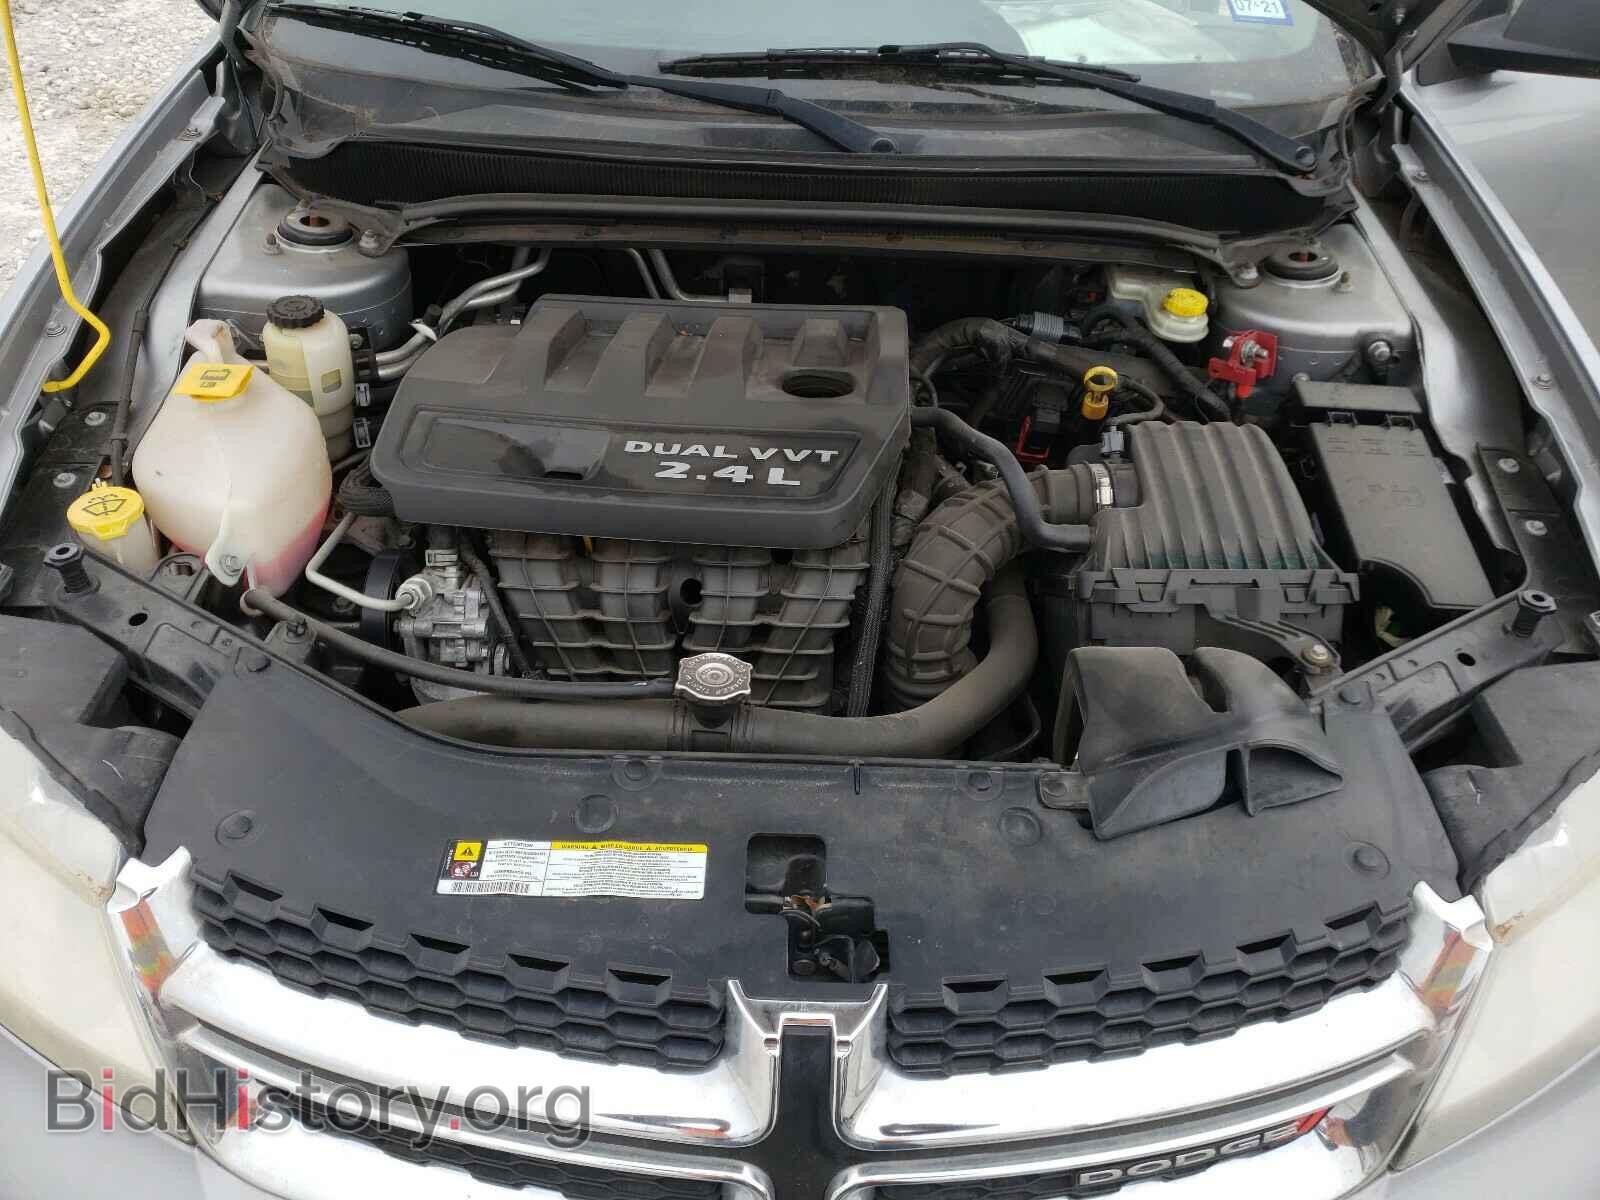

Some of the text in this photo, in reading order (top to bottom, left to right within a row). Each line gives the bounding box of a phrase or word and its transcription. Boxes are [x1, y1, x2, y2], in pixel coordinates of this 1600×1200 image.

[624, 440, 839, 463] DUAL VVT
[654, 461, 753, 483] 2.4
[1079, 1118, 1298, 1186] DODGE
